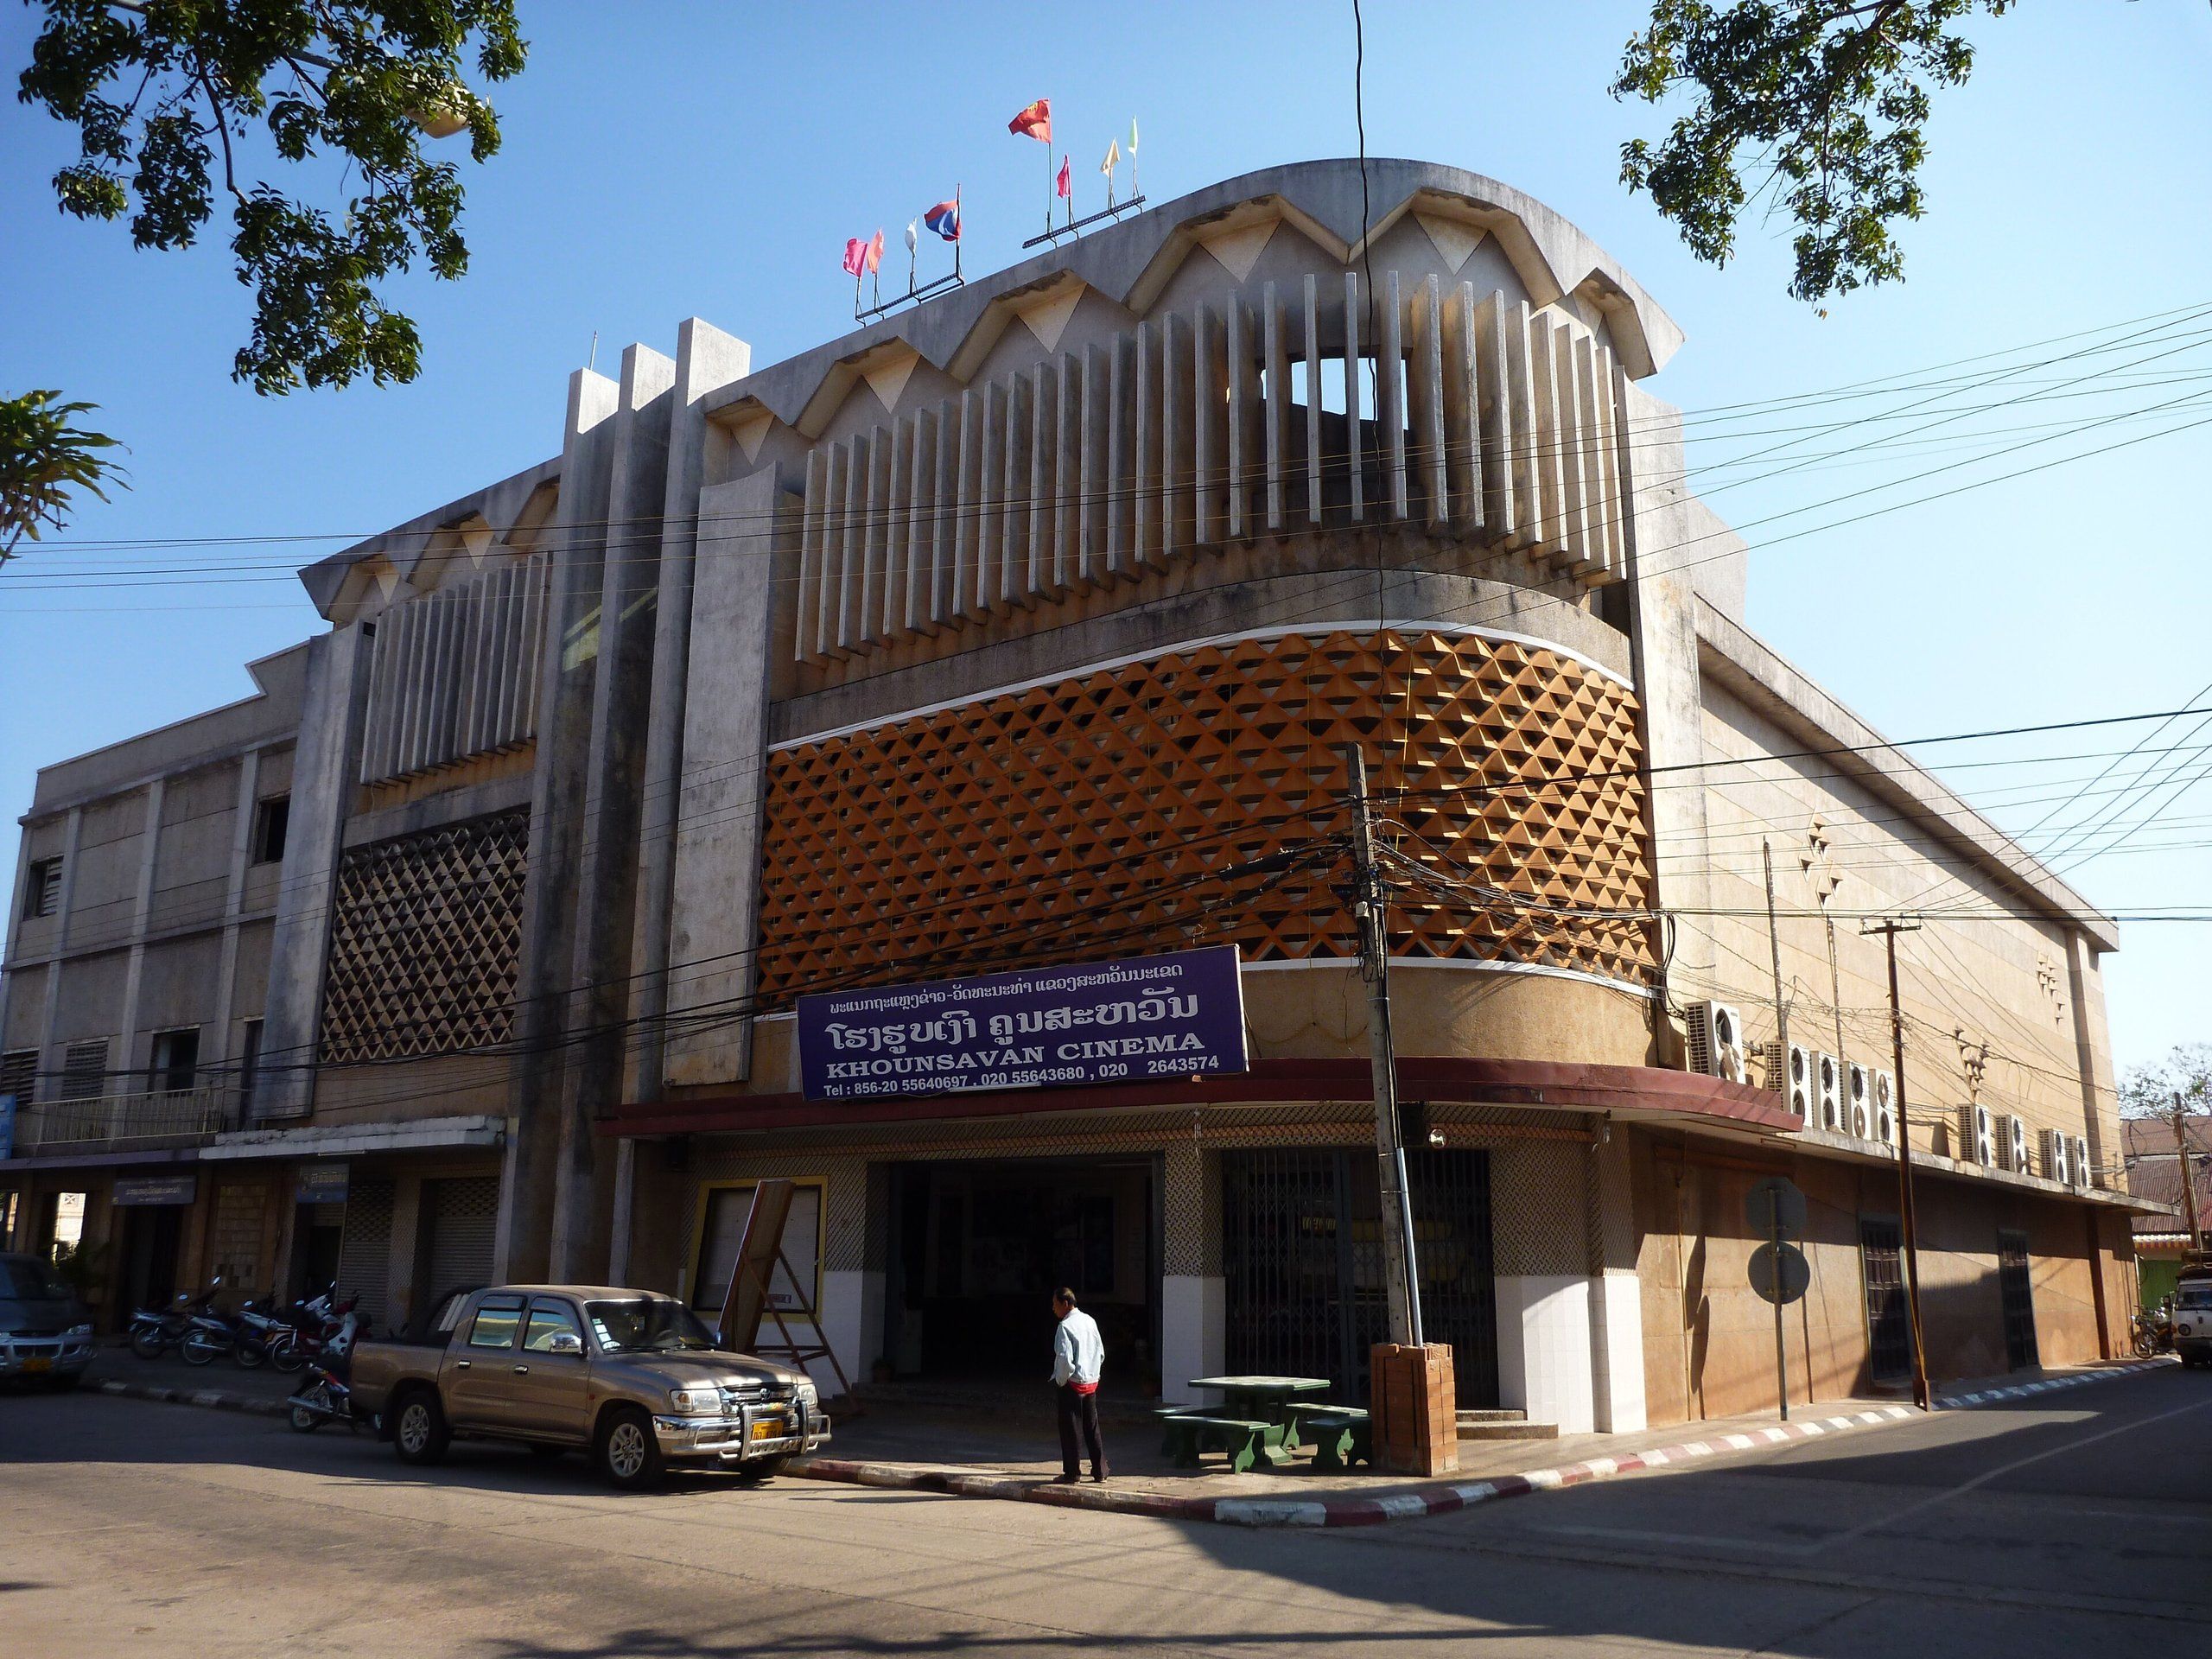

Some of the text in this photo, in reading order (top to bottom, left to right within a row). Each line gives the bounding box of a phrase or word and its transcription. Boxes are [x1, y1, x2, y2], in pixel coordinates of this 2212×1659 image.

[988, 986, 1199, 1046] ຄູນສະຫວັນ
[823, 1084, 843, 1096] Tel
[854, 1080, 898, 1094] 856-20
[901, 1074, 969, 1090] 55640697
[981, 1072, 1008, 1086] 020
[1012, 1065, 1084, 1084] 55643680
[1098, 1063, 1128, 1077] 020
[1147, 1055, 1219, 1075] 2643574
[826, 1033, 1205, 1078] KHOUNSAVAN CINEMA
